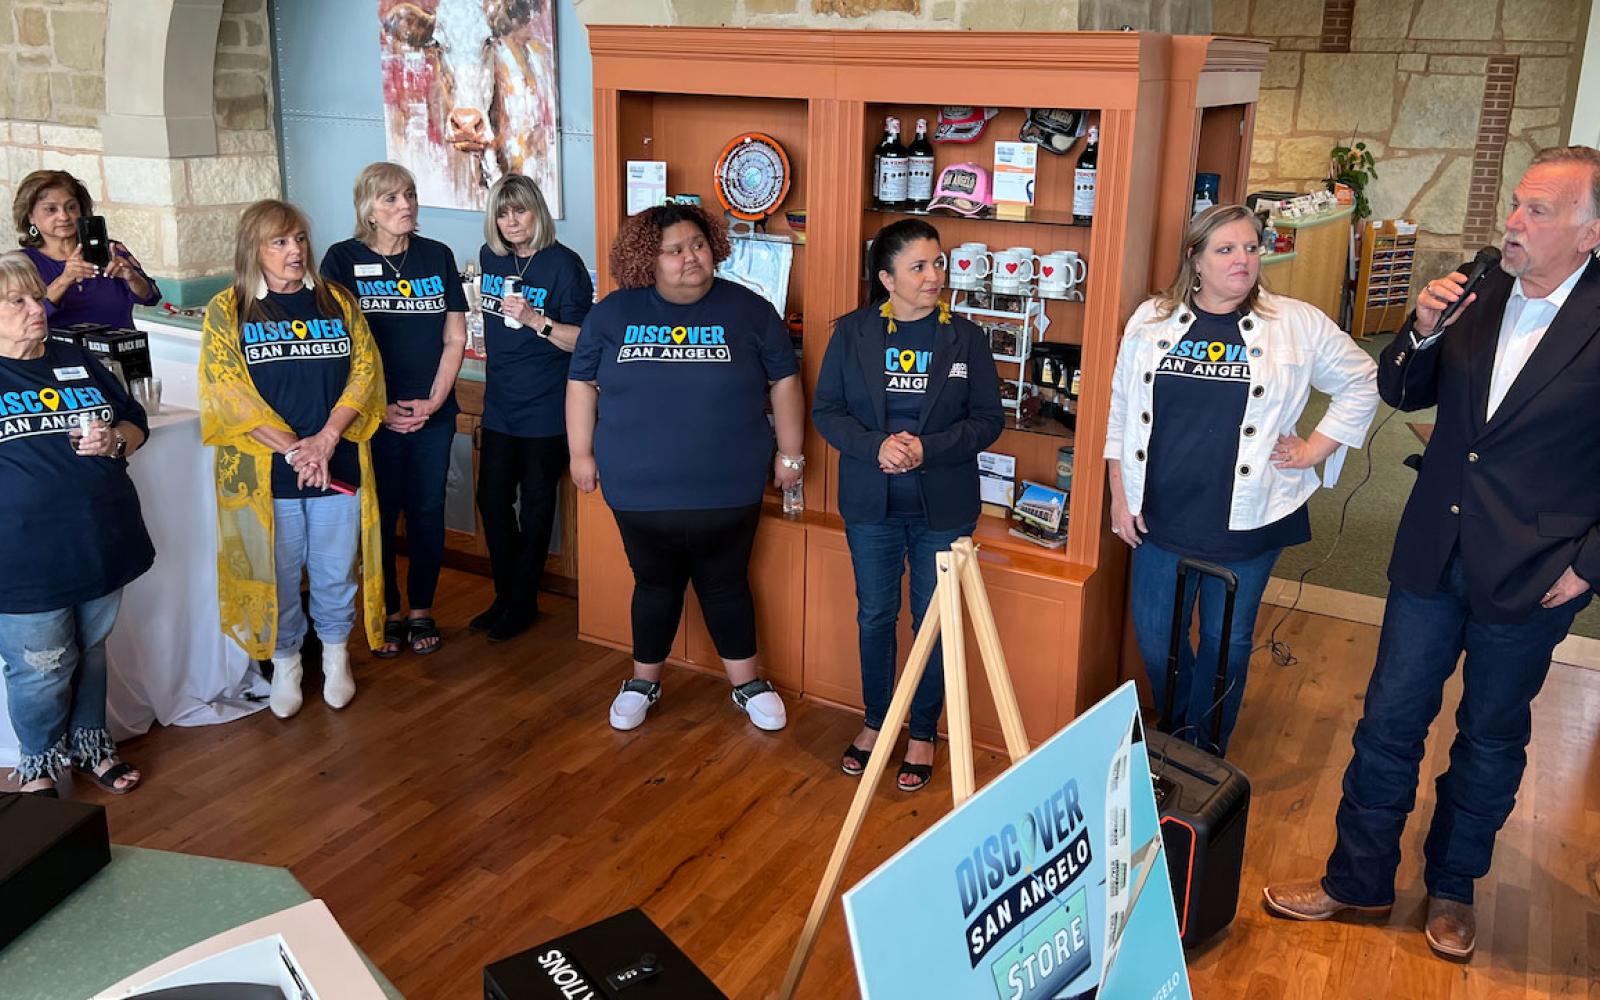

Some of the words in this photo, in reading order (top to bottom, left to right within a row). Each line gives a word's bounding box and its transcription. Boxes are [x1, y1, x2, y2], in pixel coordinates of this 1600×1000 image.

[356, 275, 445, 298] DISCOVER
[362, 298, 390, 310] SAN
[396, 298, 445, 311] ANGELO
[481, 297, 496, 310] AN
[244, 318, 347, 343] DISCOVER
[623, 325, 726, 345] DISCOVER
[249, 345, 283, 360] SAN
[290, 341, 347, 356] ANGELO
[622, 347, 654, 358] SAN
[660, 348, 726, 359] ANGELO
[1161, 358, 1186, 372] AN
[1192, 363, 1251, 378] ANGEL
[888, 376, 928, 390] ANG
[0, 387, 107, 416] ISCOVER
[0, 418, 31, 438] AN
[955, 777, 1084, 920] DISCOVER
[971, 899, 1012, 955] SAN
[1020, 838, 1089, 913] ANGELO
[1007, 916, 1086, 1000] STORE
